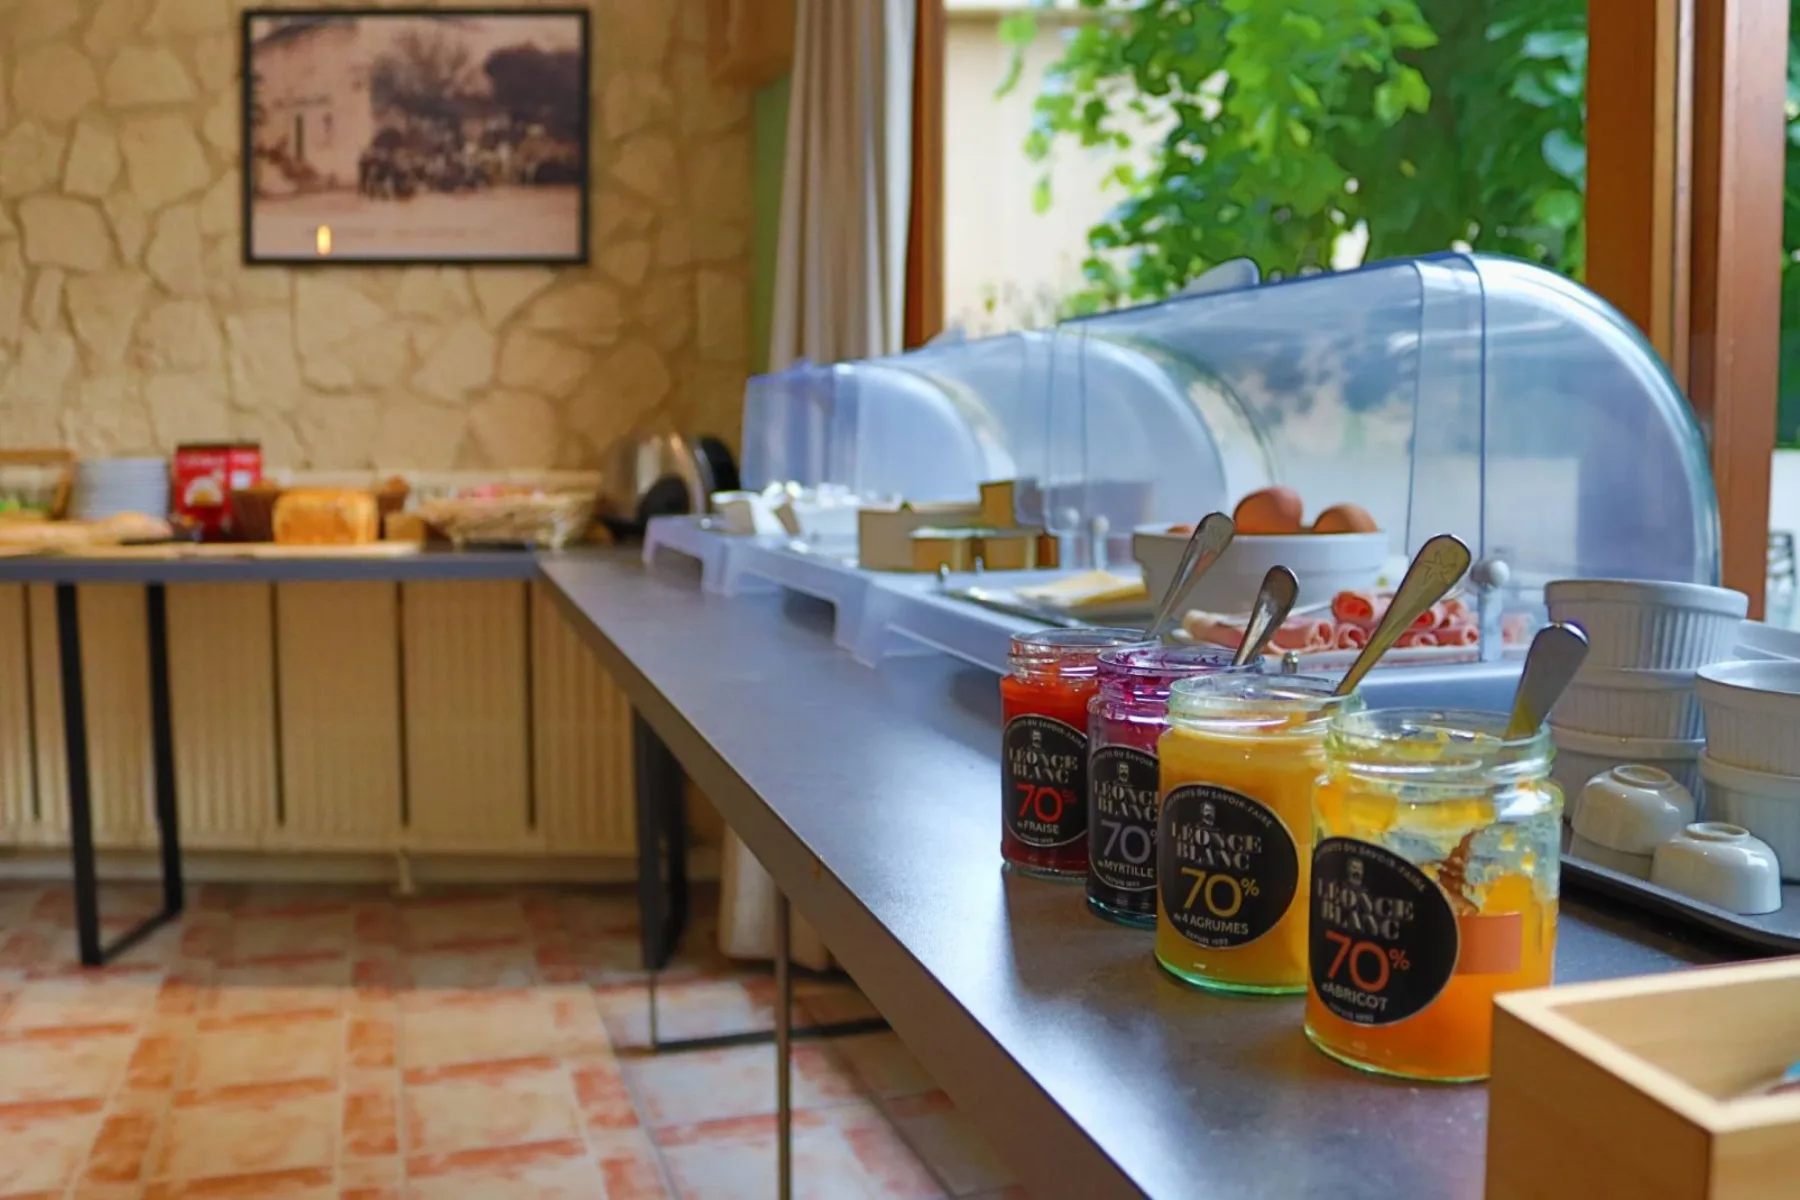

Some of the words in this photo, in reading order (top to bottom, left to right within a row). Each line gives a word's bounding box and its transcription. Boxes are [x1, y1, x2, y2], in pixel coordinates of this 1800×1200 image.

[1013, 762, 1069, 783] BLANC
[1016, 783, 1077, 822] 70%
[1099, 797, 1157, 821] BLANC
[1197, 789, 1209, 797] DU
[1212, 791, 1273, 828] SAVOIR-FAIRE
[1024, 819, 1059, 835] FRAISE
[1172, 822, 1262, 853] LÉONCE
[1104, 859, 1154, 878] MYRTILLE
[1177, 842, 1249, 869] BLANC
[1181, 867, 1259, 917] 70%
[1190, 915, 1249, 935] AGRUMES
[1322, 901, 1399, 939] BLANC
[1325, 931, 1410, 992] 70%
